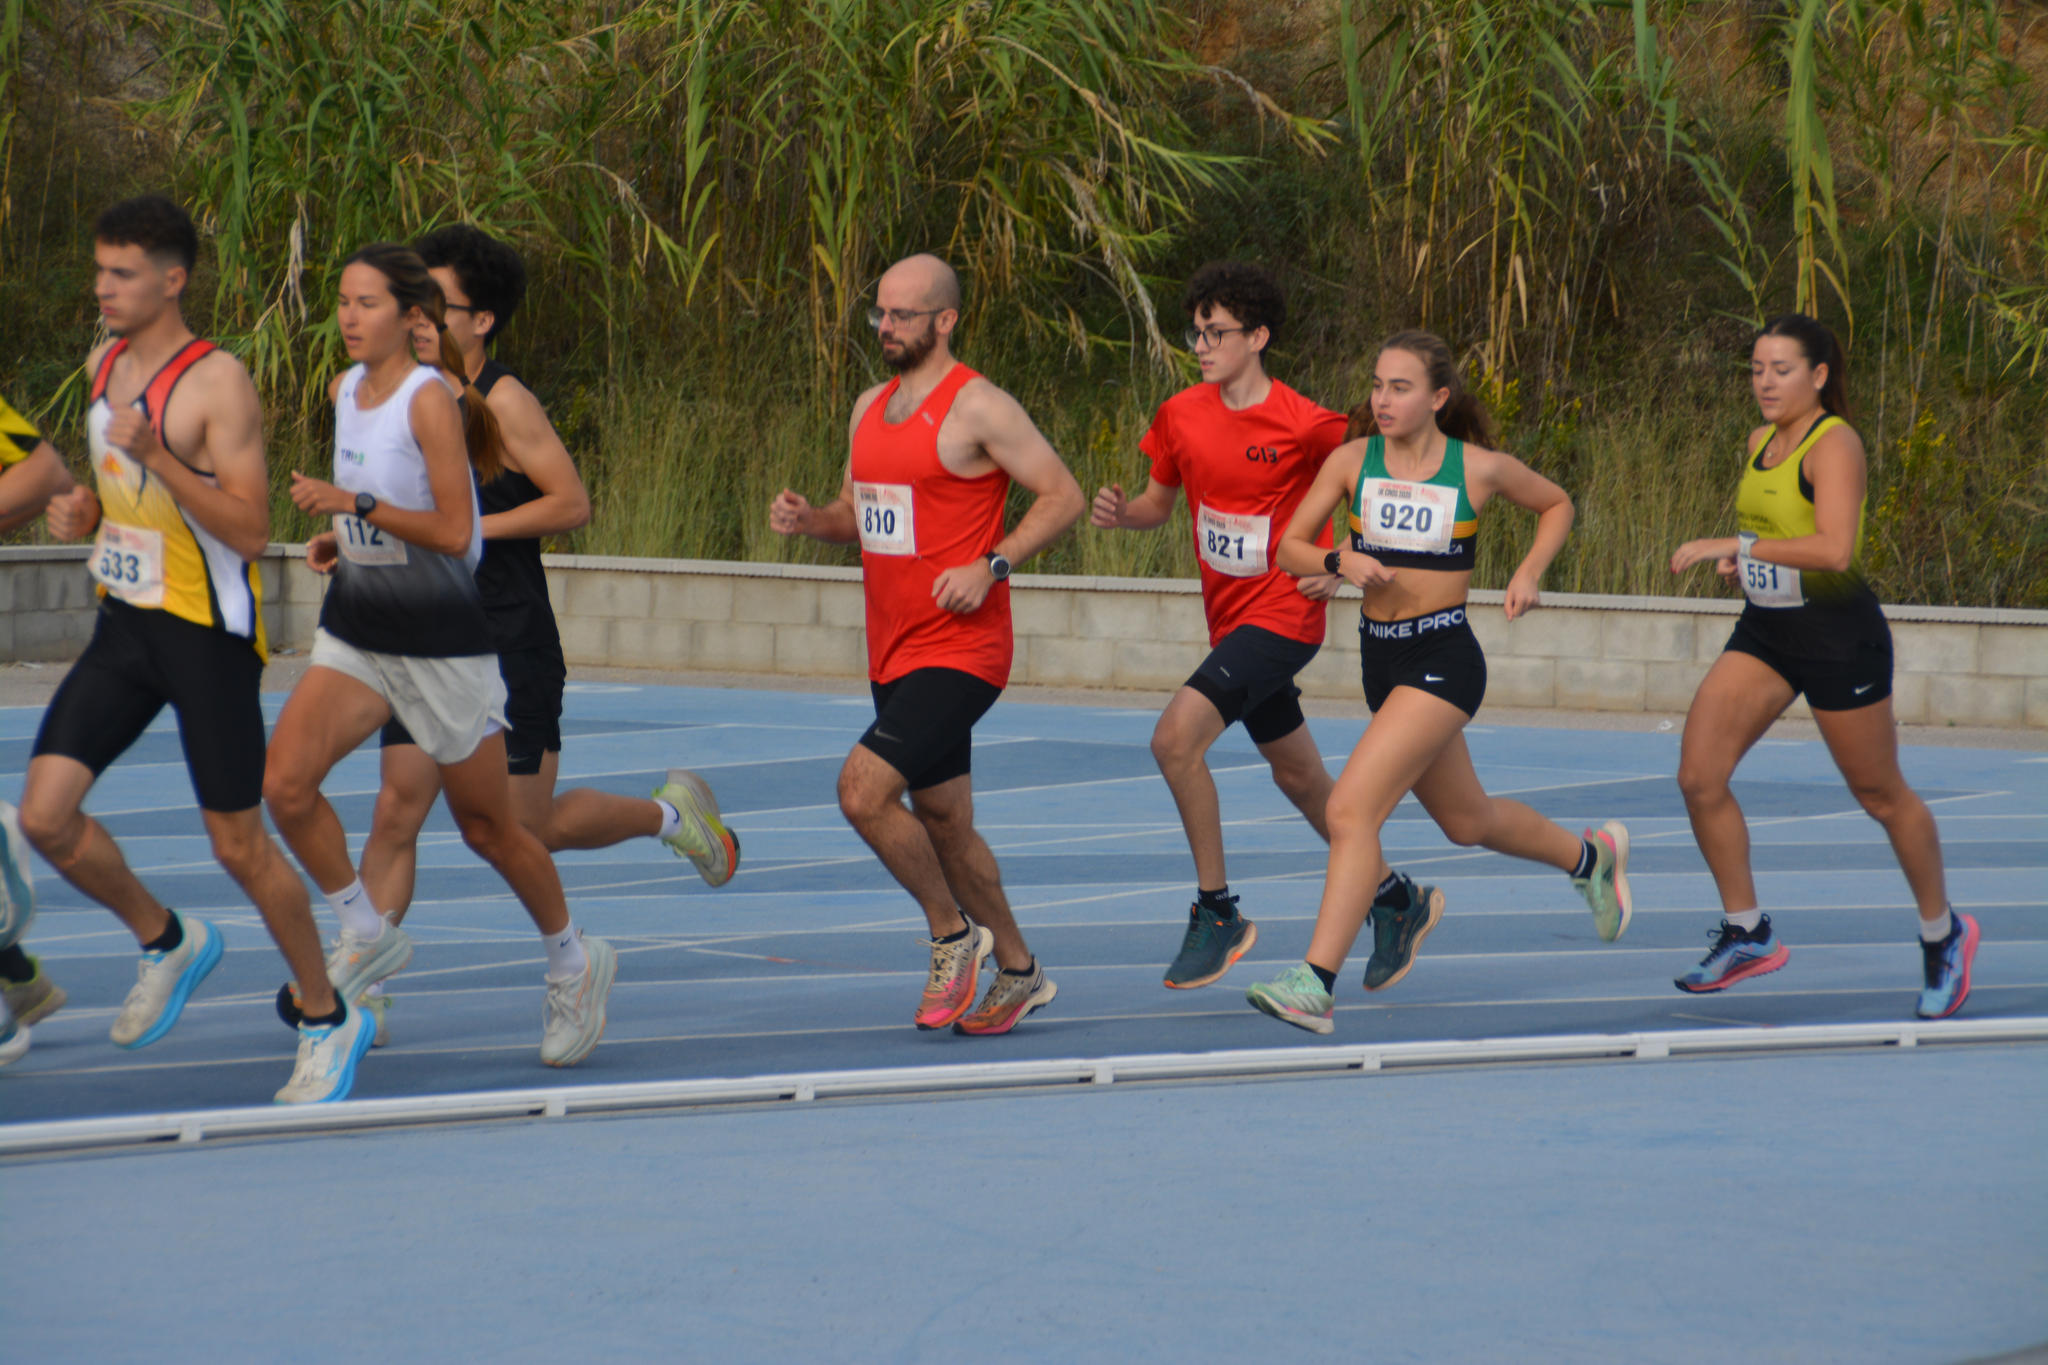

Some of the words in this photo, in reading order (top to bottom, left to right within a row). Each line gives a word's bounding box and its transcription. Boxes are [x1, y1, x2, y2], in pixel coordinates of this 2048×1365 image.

[344, 517, 384, 546] 112
[865, 506, 896, 535] 810
[1380, 503, 1433, 533] 920
[1208, 529, 1245, 560] 821
[101, 548, 140, 583] 533
[1747, 562, 1778, 590] 551
[1369, 621, 1413, 639] NIKE
[1418, 609, 1465, 634] PRO
